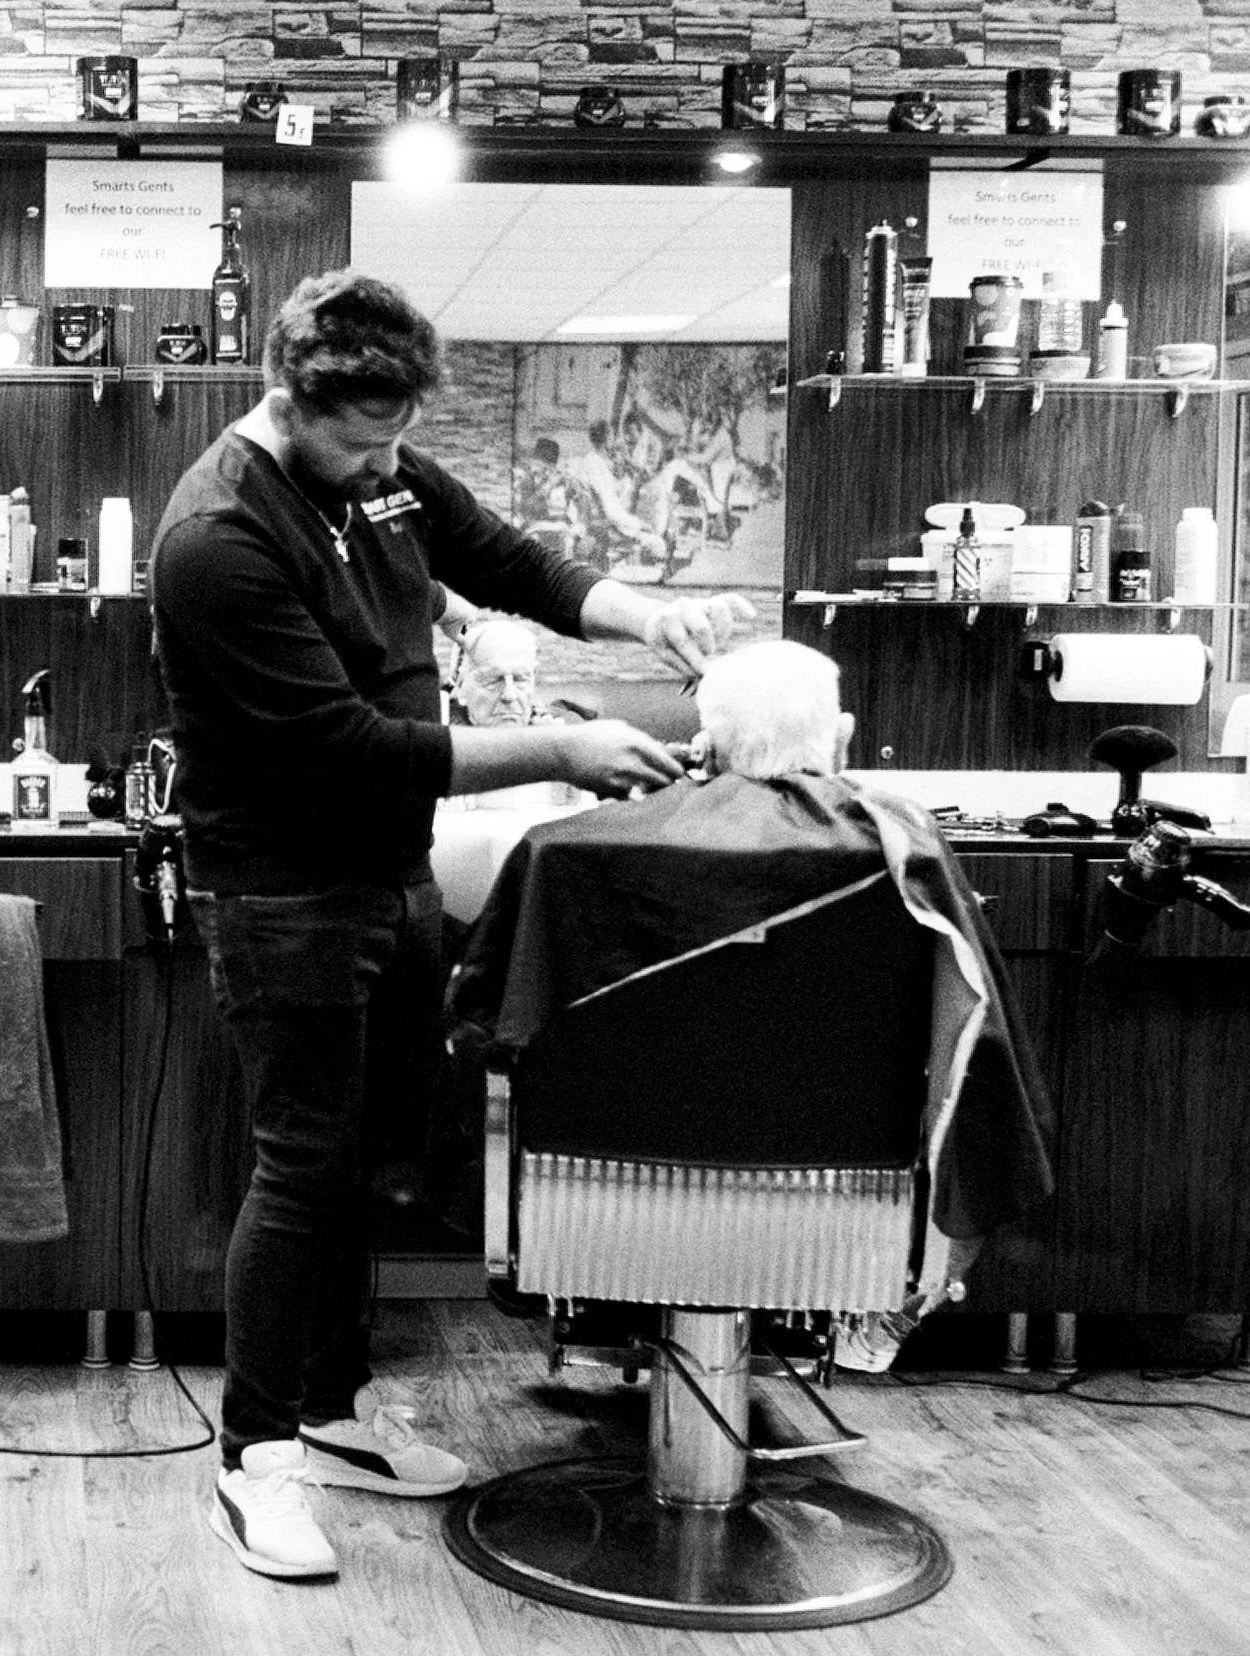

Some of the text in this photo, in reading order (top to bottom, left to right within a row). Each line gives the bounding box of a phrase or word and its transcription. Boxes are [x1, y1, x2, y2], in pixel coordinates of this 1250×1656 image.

[93, 180, 175, 192] Smarts Gents
[1021, 191, 1056, 203] Gents
[65, 203, 202, 216] feel free to connect to
[948, 213, 1081, 226] feel free to connect to
[122, 227, 143, 236] our
[1004, 238, 1025, 247] our
[100, 249, 129, 260] FREE
[982, 259, 1010, 271] FREE
